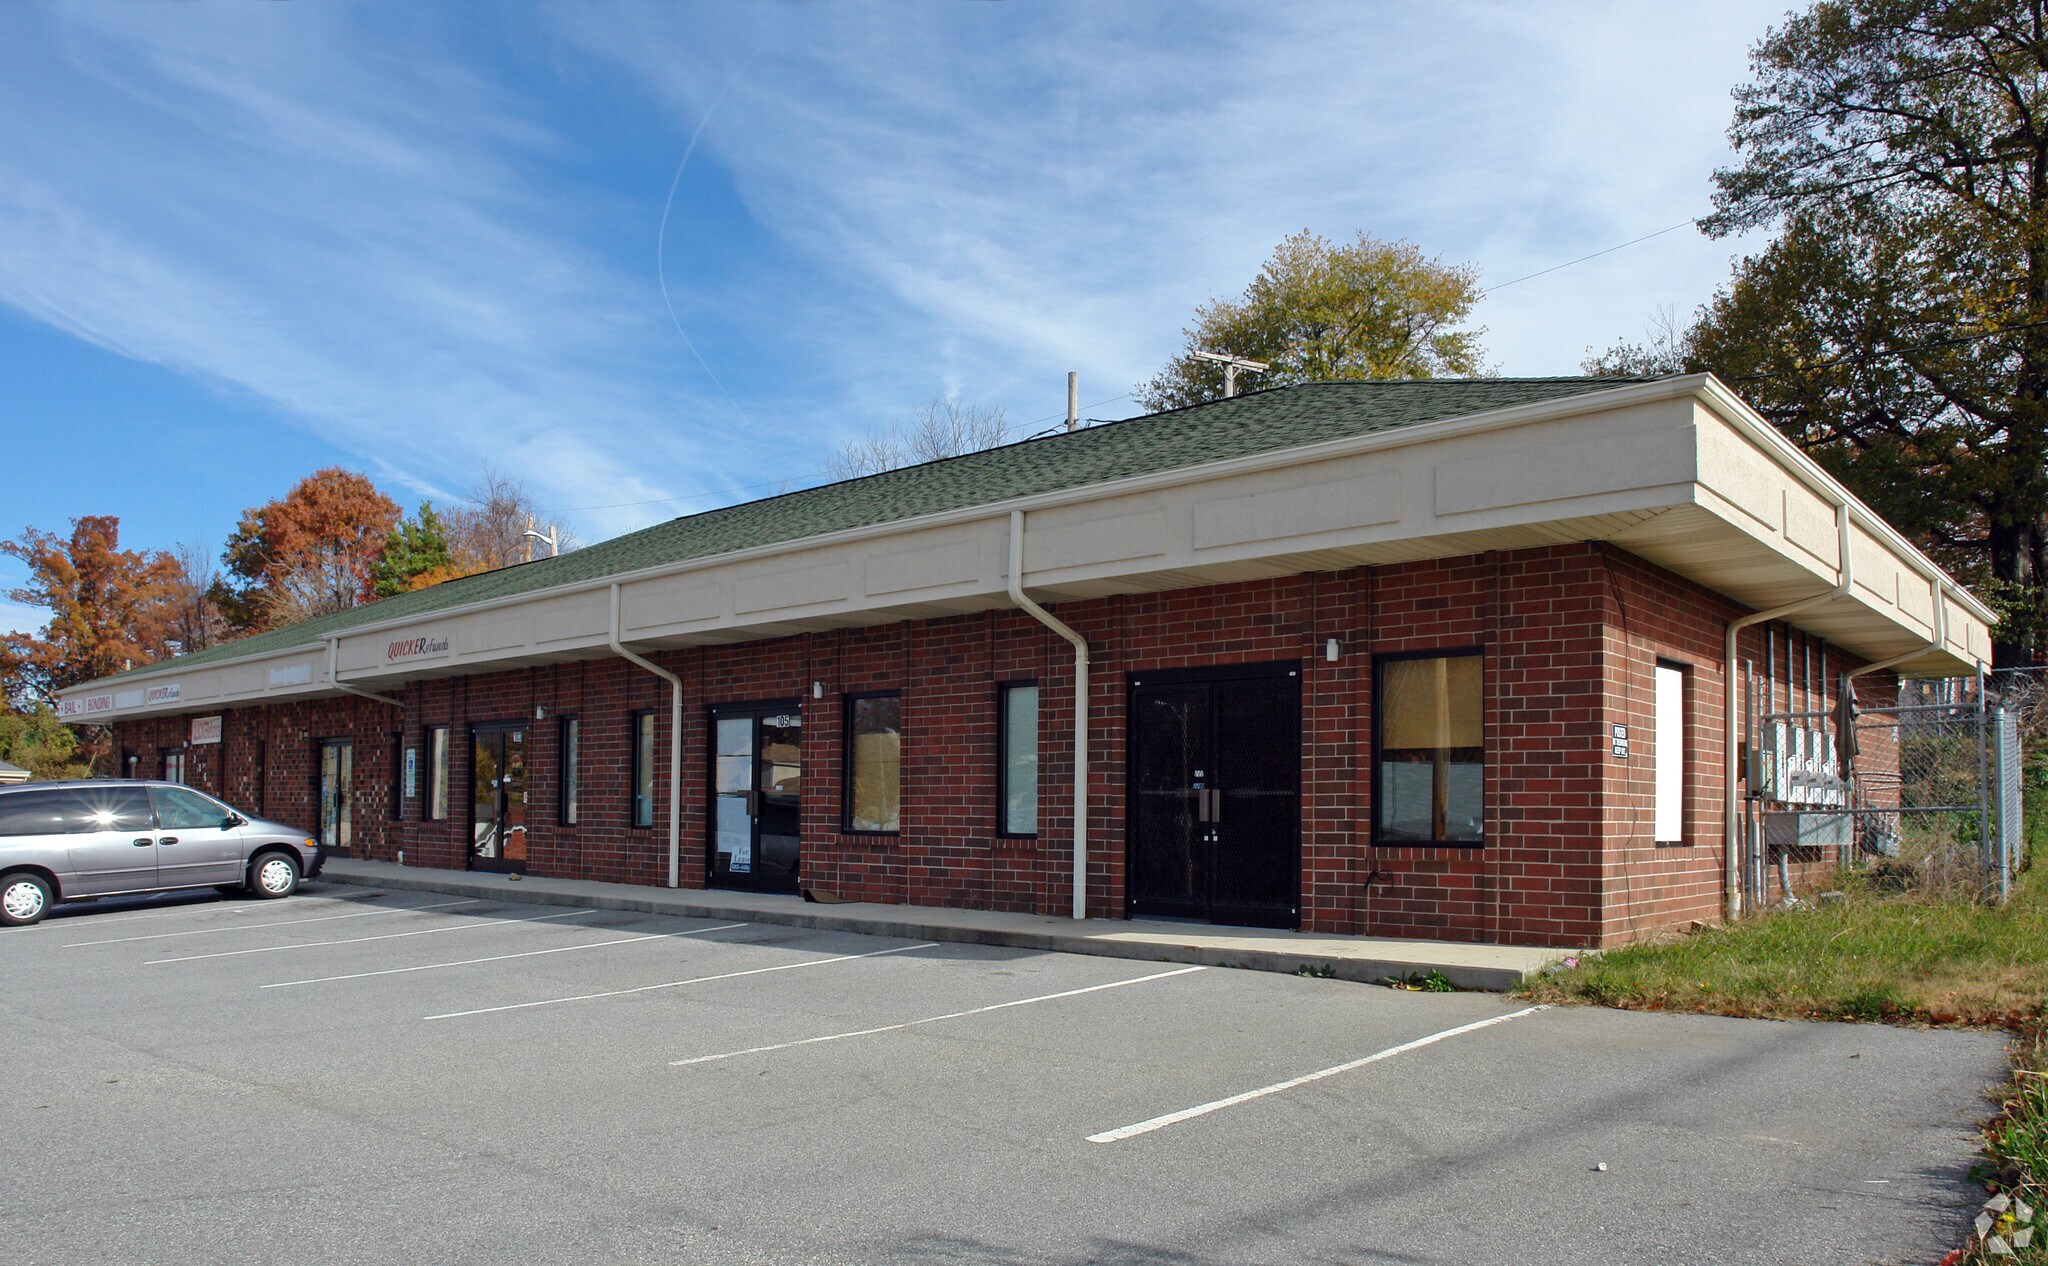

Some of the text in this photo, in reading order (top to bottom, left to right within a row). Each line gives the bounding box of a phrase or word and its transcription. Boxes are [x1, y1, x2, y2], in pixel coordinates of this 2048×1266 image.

[64, 696, 111, 715] BAIL BONDING
[777, 715, 789, 727] 105
